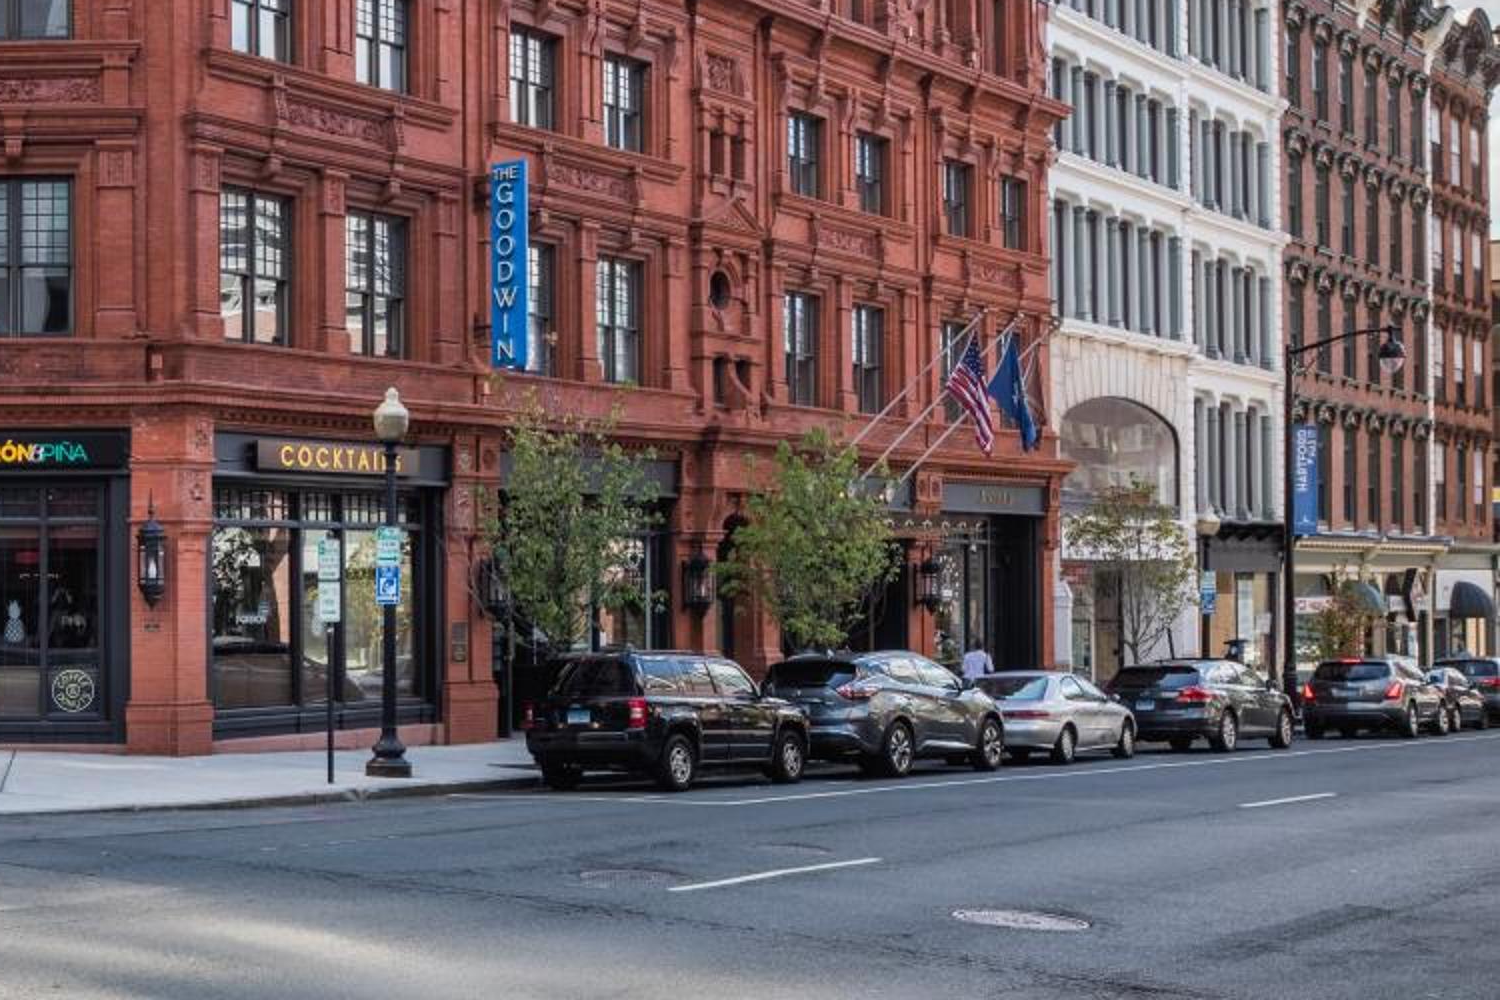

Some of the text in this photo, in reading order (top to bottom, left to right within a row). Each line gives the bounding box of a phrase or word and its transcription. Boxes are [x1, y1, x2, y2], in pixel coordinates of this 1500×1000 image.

[493, 165, 519, 180] THE
[493, 183, 518, 360] GOODWIN
[1296, 429, 1308, 491] HARTFORD
